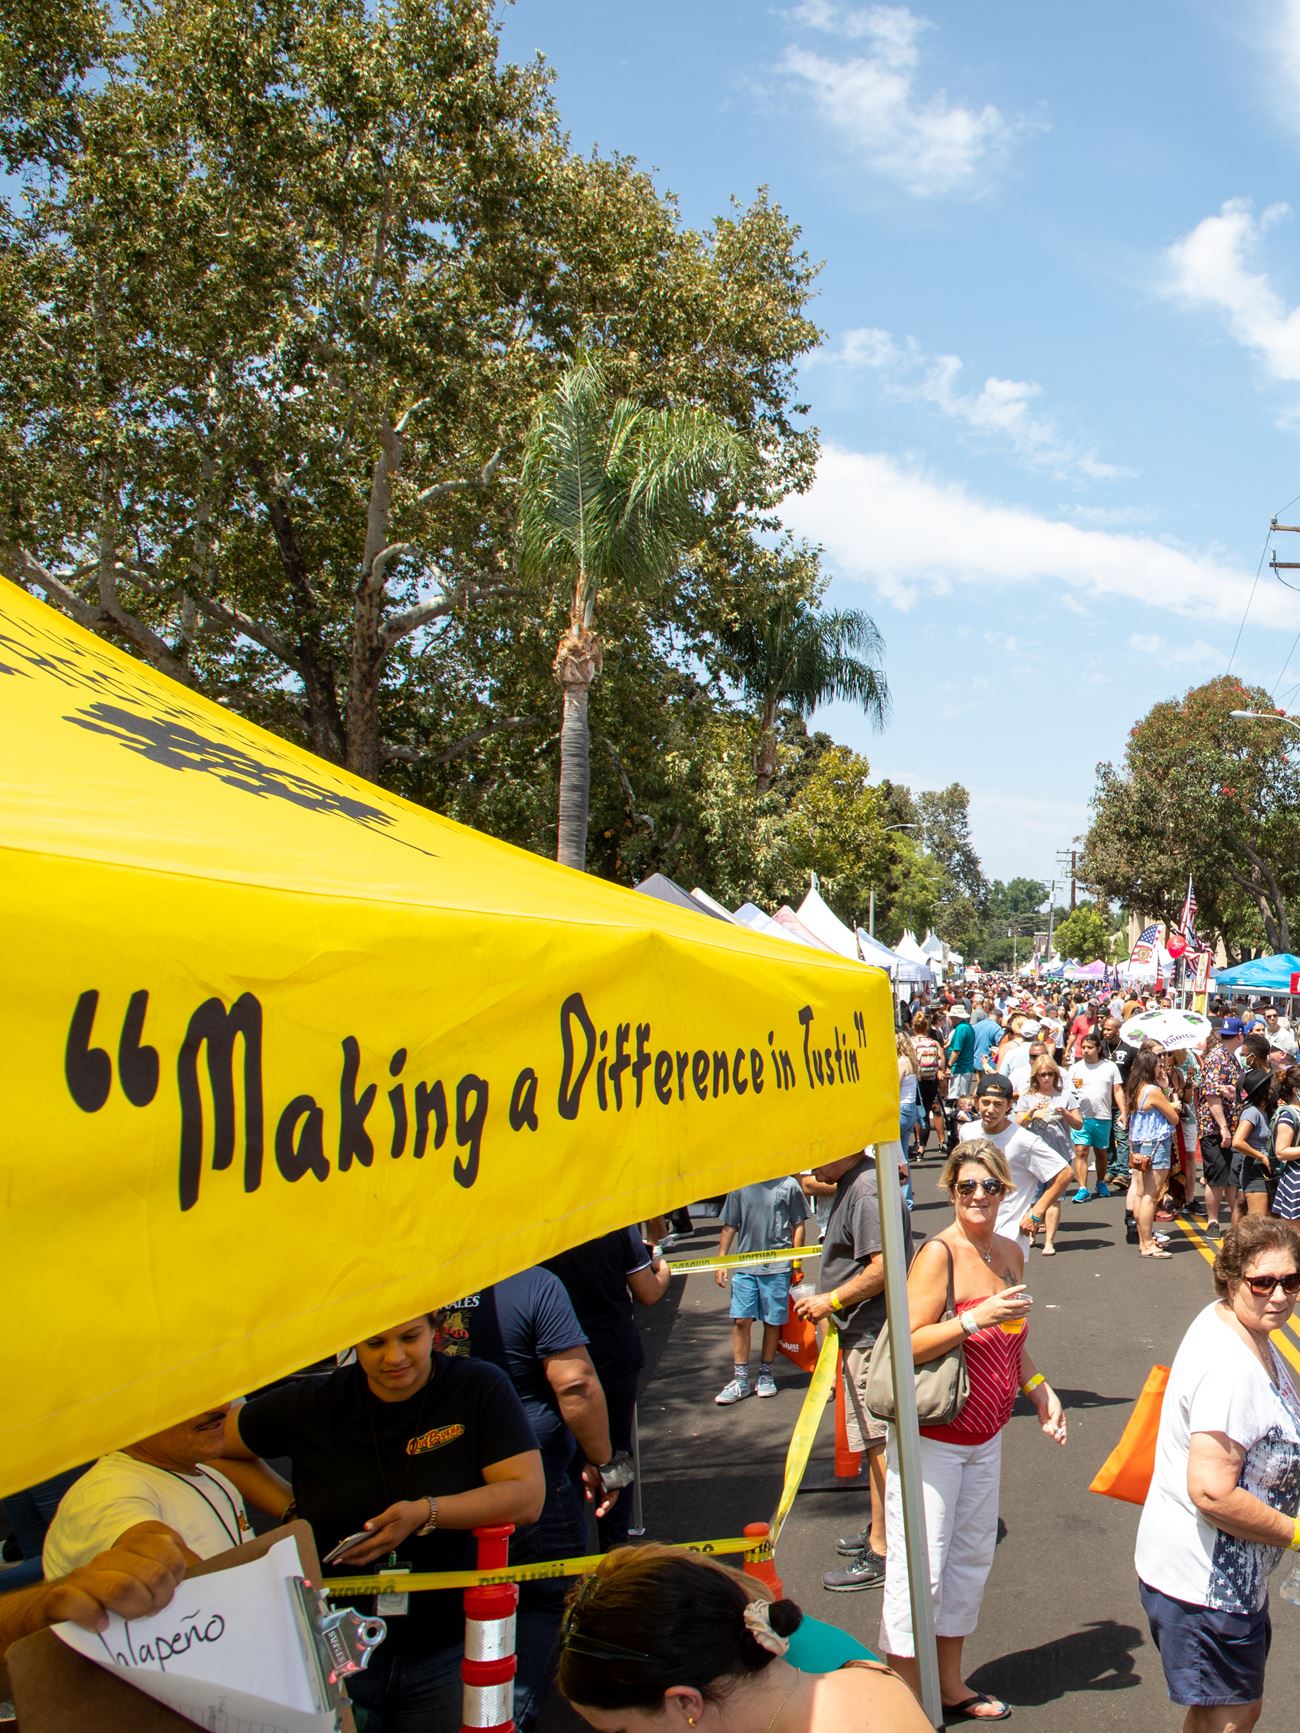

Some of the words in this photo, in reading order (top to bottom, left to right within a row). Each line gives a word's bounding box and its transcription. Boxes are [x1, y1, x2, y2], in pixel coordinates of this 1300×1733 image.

[509, 1066, 539, 1132] a
[558, 992, 764, 1120] Difference
[767, 1030, 796, 1091] in
